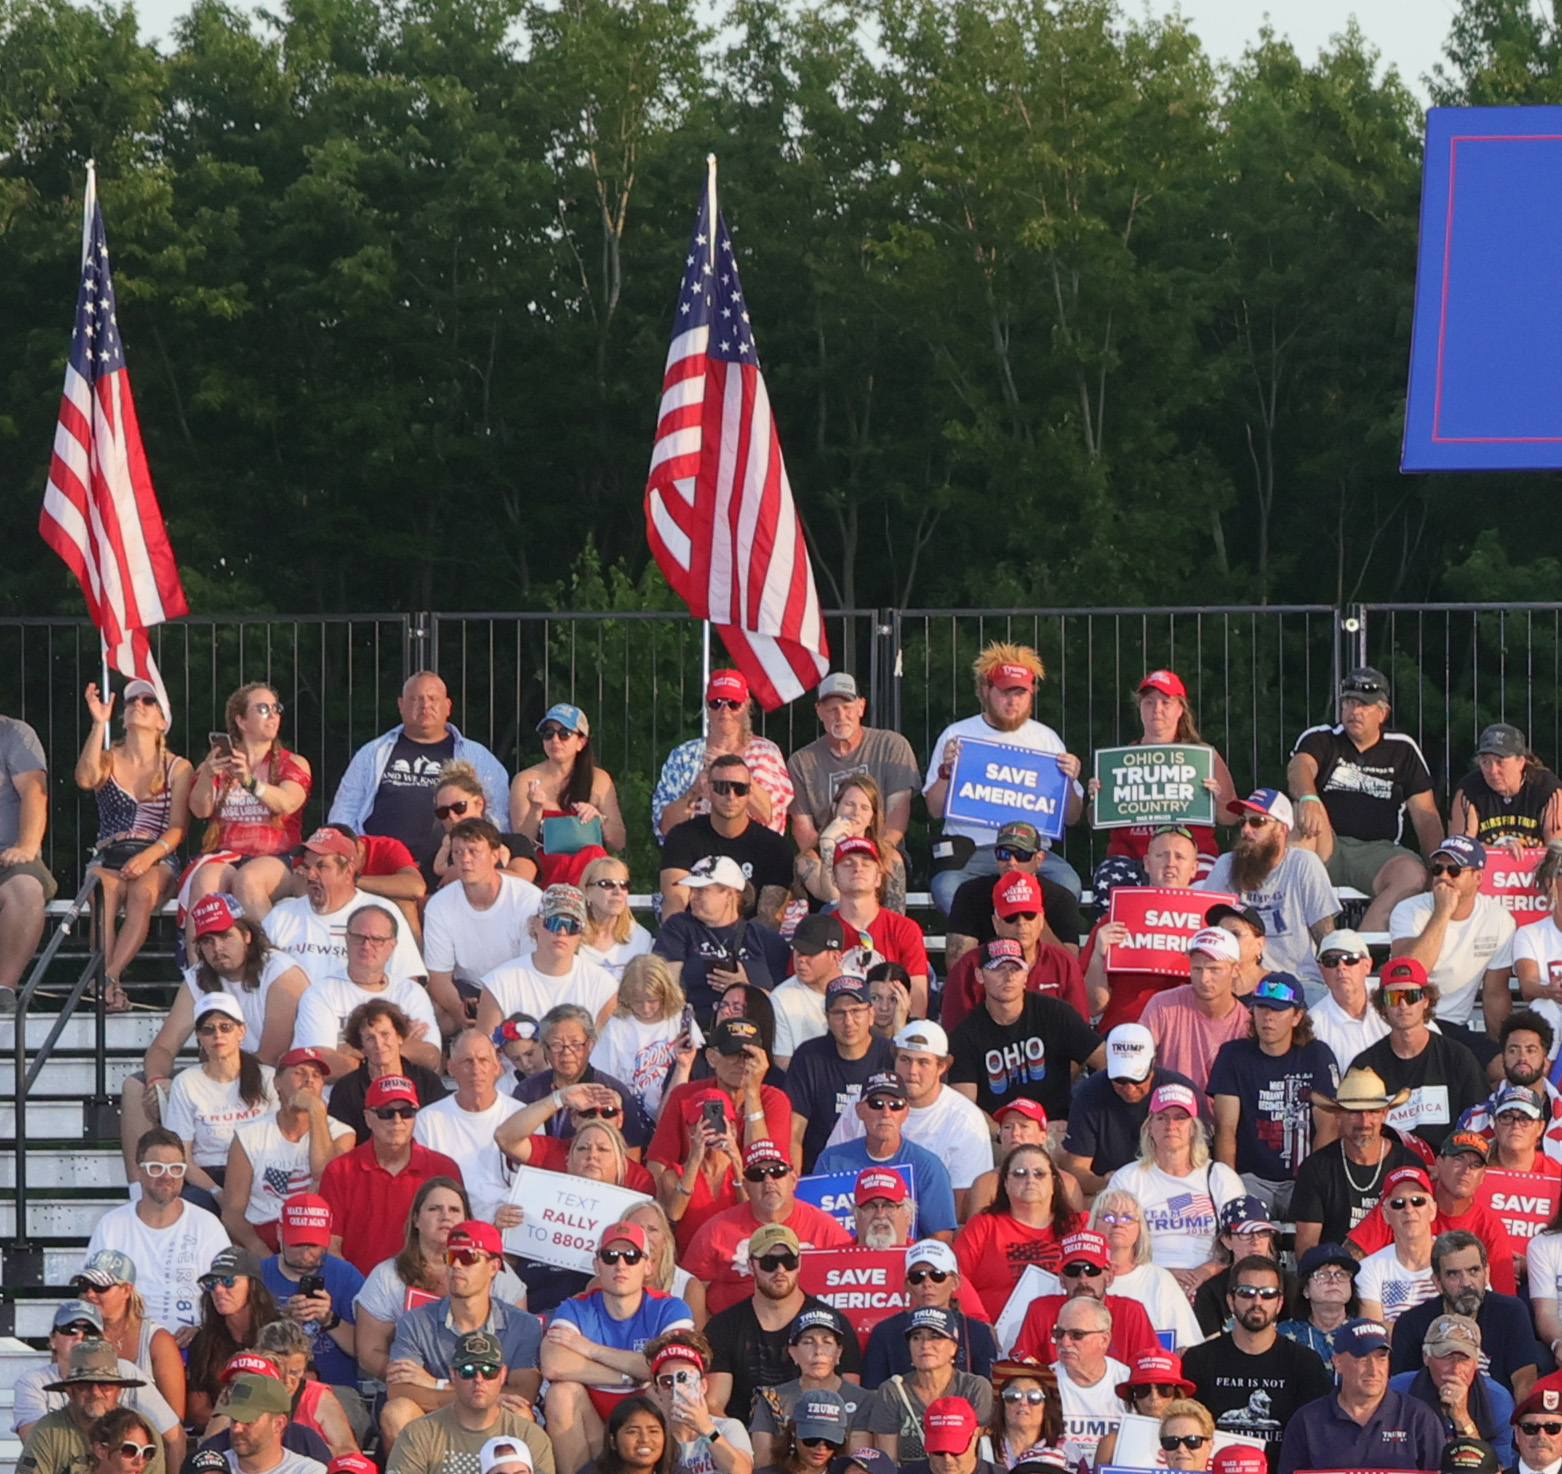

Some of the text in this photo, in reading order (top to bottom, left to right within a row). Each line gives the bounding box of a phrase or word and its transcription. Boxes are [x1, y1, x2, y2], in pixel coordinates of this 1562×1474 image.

[1123, 751, 1185, 766] OHIO IS
[985, 763, 1038, 788] SAVE
[1112, 765, 1197, 784] TRUMP
[960, 782, 1057, 814] AMERICA!
[1113, 783, 1195, 803] MILLER
[1118, 801, 1190, 814] COUNTRY
[1441, 838, 1474, 852] TRUMP
[1493, 872, 1532, 888] SAV
[1145, 910, 1202, 931] SAVE
[1120, 932, 1192, 952] AMERI
[1112, 1043, 1144, 1052] TRUMP
[985, 1036, 1046, 1077] OHIO
[378, 1077, 412, 1088] TRUMP
[200, 1109, 260, 1122] TRUMP
[751, 1141, 774, 1150] CNN
[747, 1148, 782, 1161] SUCKS
[556, 1190, 600, 1211] TEXT
[1491, 1193, 1551, 1215] SAVE
[287, 1207, 329, 1216] MAKE AMERICA
[1145, 1209, 1179, 1221] TEAM
[289, 1218, 326, 1226] GREAT AGAIN
[542, 1209, 599, 1232] RALLY
[1144, 1215, 1214, 1231] TRUMP
[527, 1224, 595, 1252] TO 8802
[1062, 1234, 1104, 1246] MAKE AMERICA
[1064, 1244, 1101, 1253] GREAT AGAIN
[826, 1269, 888, 1285] SAVE
[801, 1311, 834, 1322] TRUMP
[913, 1309, 946, 1320] TRUMP
[1352, 1326, 1387, 1337] TRUMP
[656, 1347, 695, 1361] TRUMP
[1216, 1377, 1285, 1388] FEAR IS NOT
[808, 1403, 841, 1414] TRUMP
